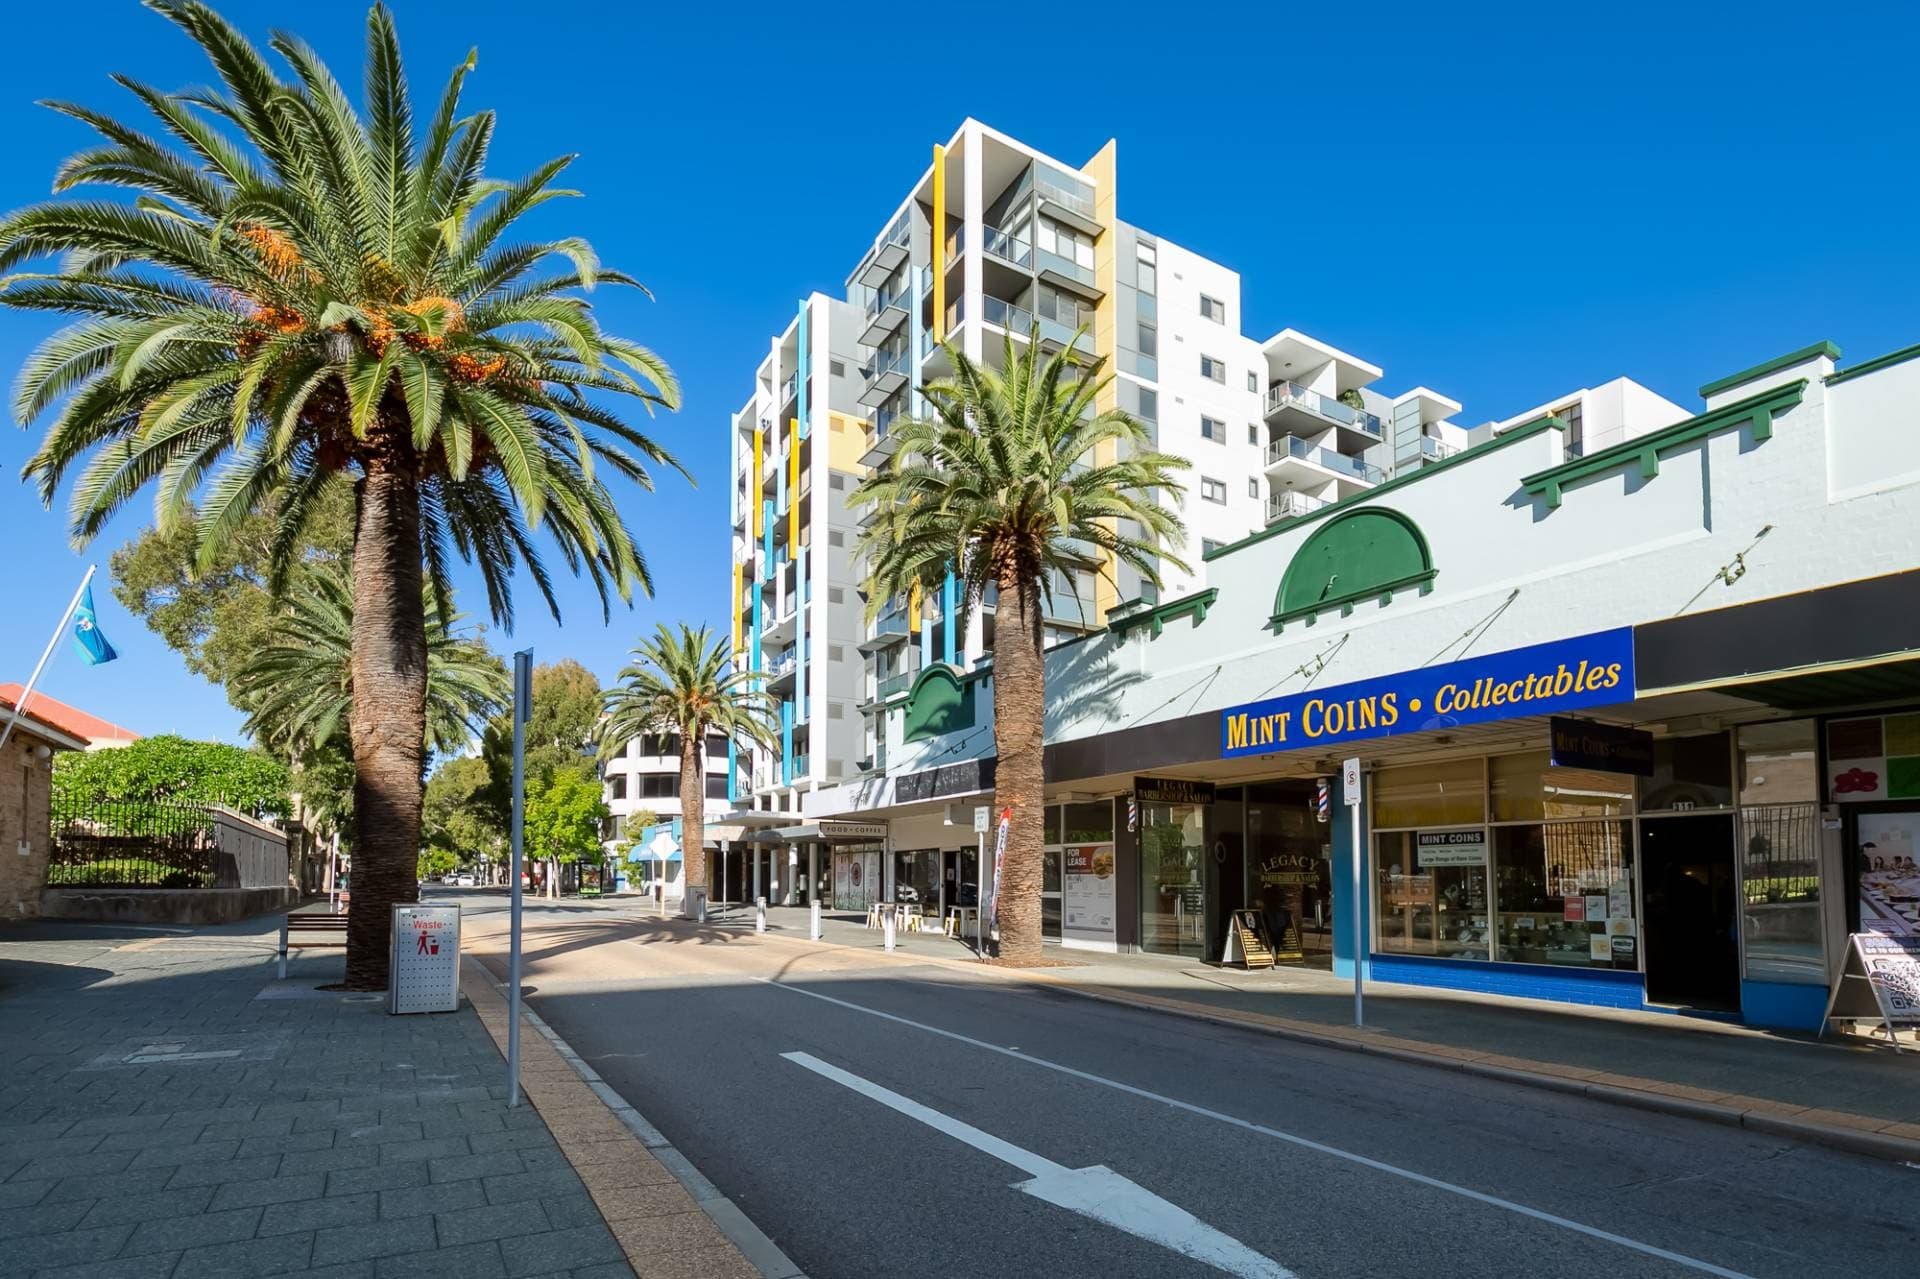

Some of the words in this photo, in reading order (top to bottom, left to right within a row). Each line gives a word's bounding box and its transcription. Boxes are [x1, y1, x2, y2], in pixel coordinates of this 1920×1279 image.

[1226, 711, 1291, 750] MINT
[1302, 692, 1399, 738] COINS
[1434, 659, 1622, 714] Collectables
[1421, 834, 1446, 844] MINT
[1449, 832, 1481, 843] COINS
[1067, 848, 1080, 857] FOR
[1067, 857, 1087, 866] LEASE
[1260, 854, 1320, 872] LEGACY
[413, 920, 443, 930] Waste
